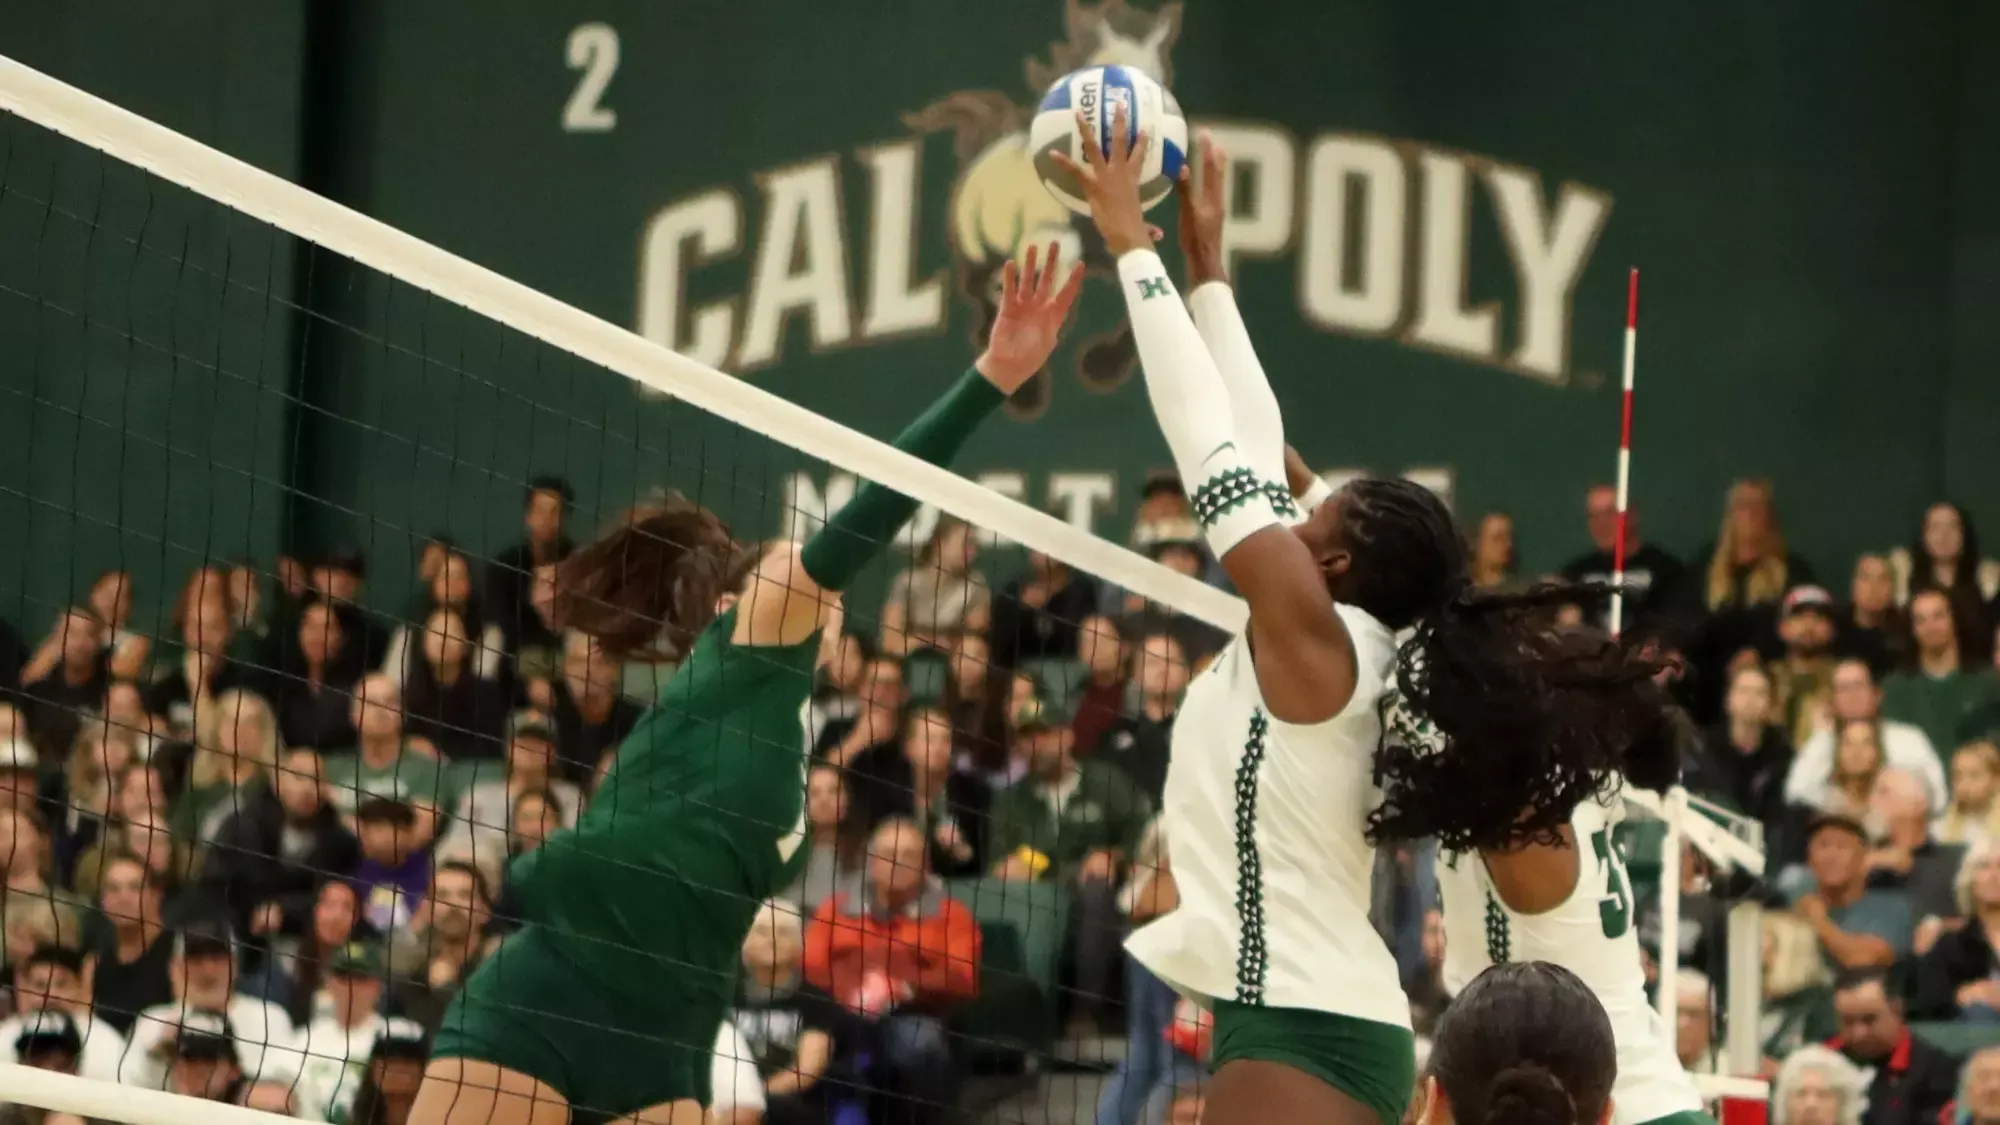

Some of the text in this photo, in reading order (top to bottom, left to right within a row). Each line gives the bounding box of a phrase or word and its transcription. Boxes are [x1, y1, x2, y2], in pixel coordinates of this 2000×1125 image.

[563, 22, 620, 131] 2
[638, 122, 1613, 399] CAL POLY
